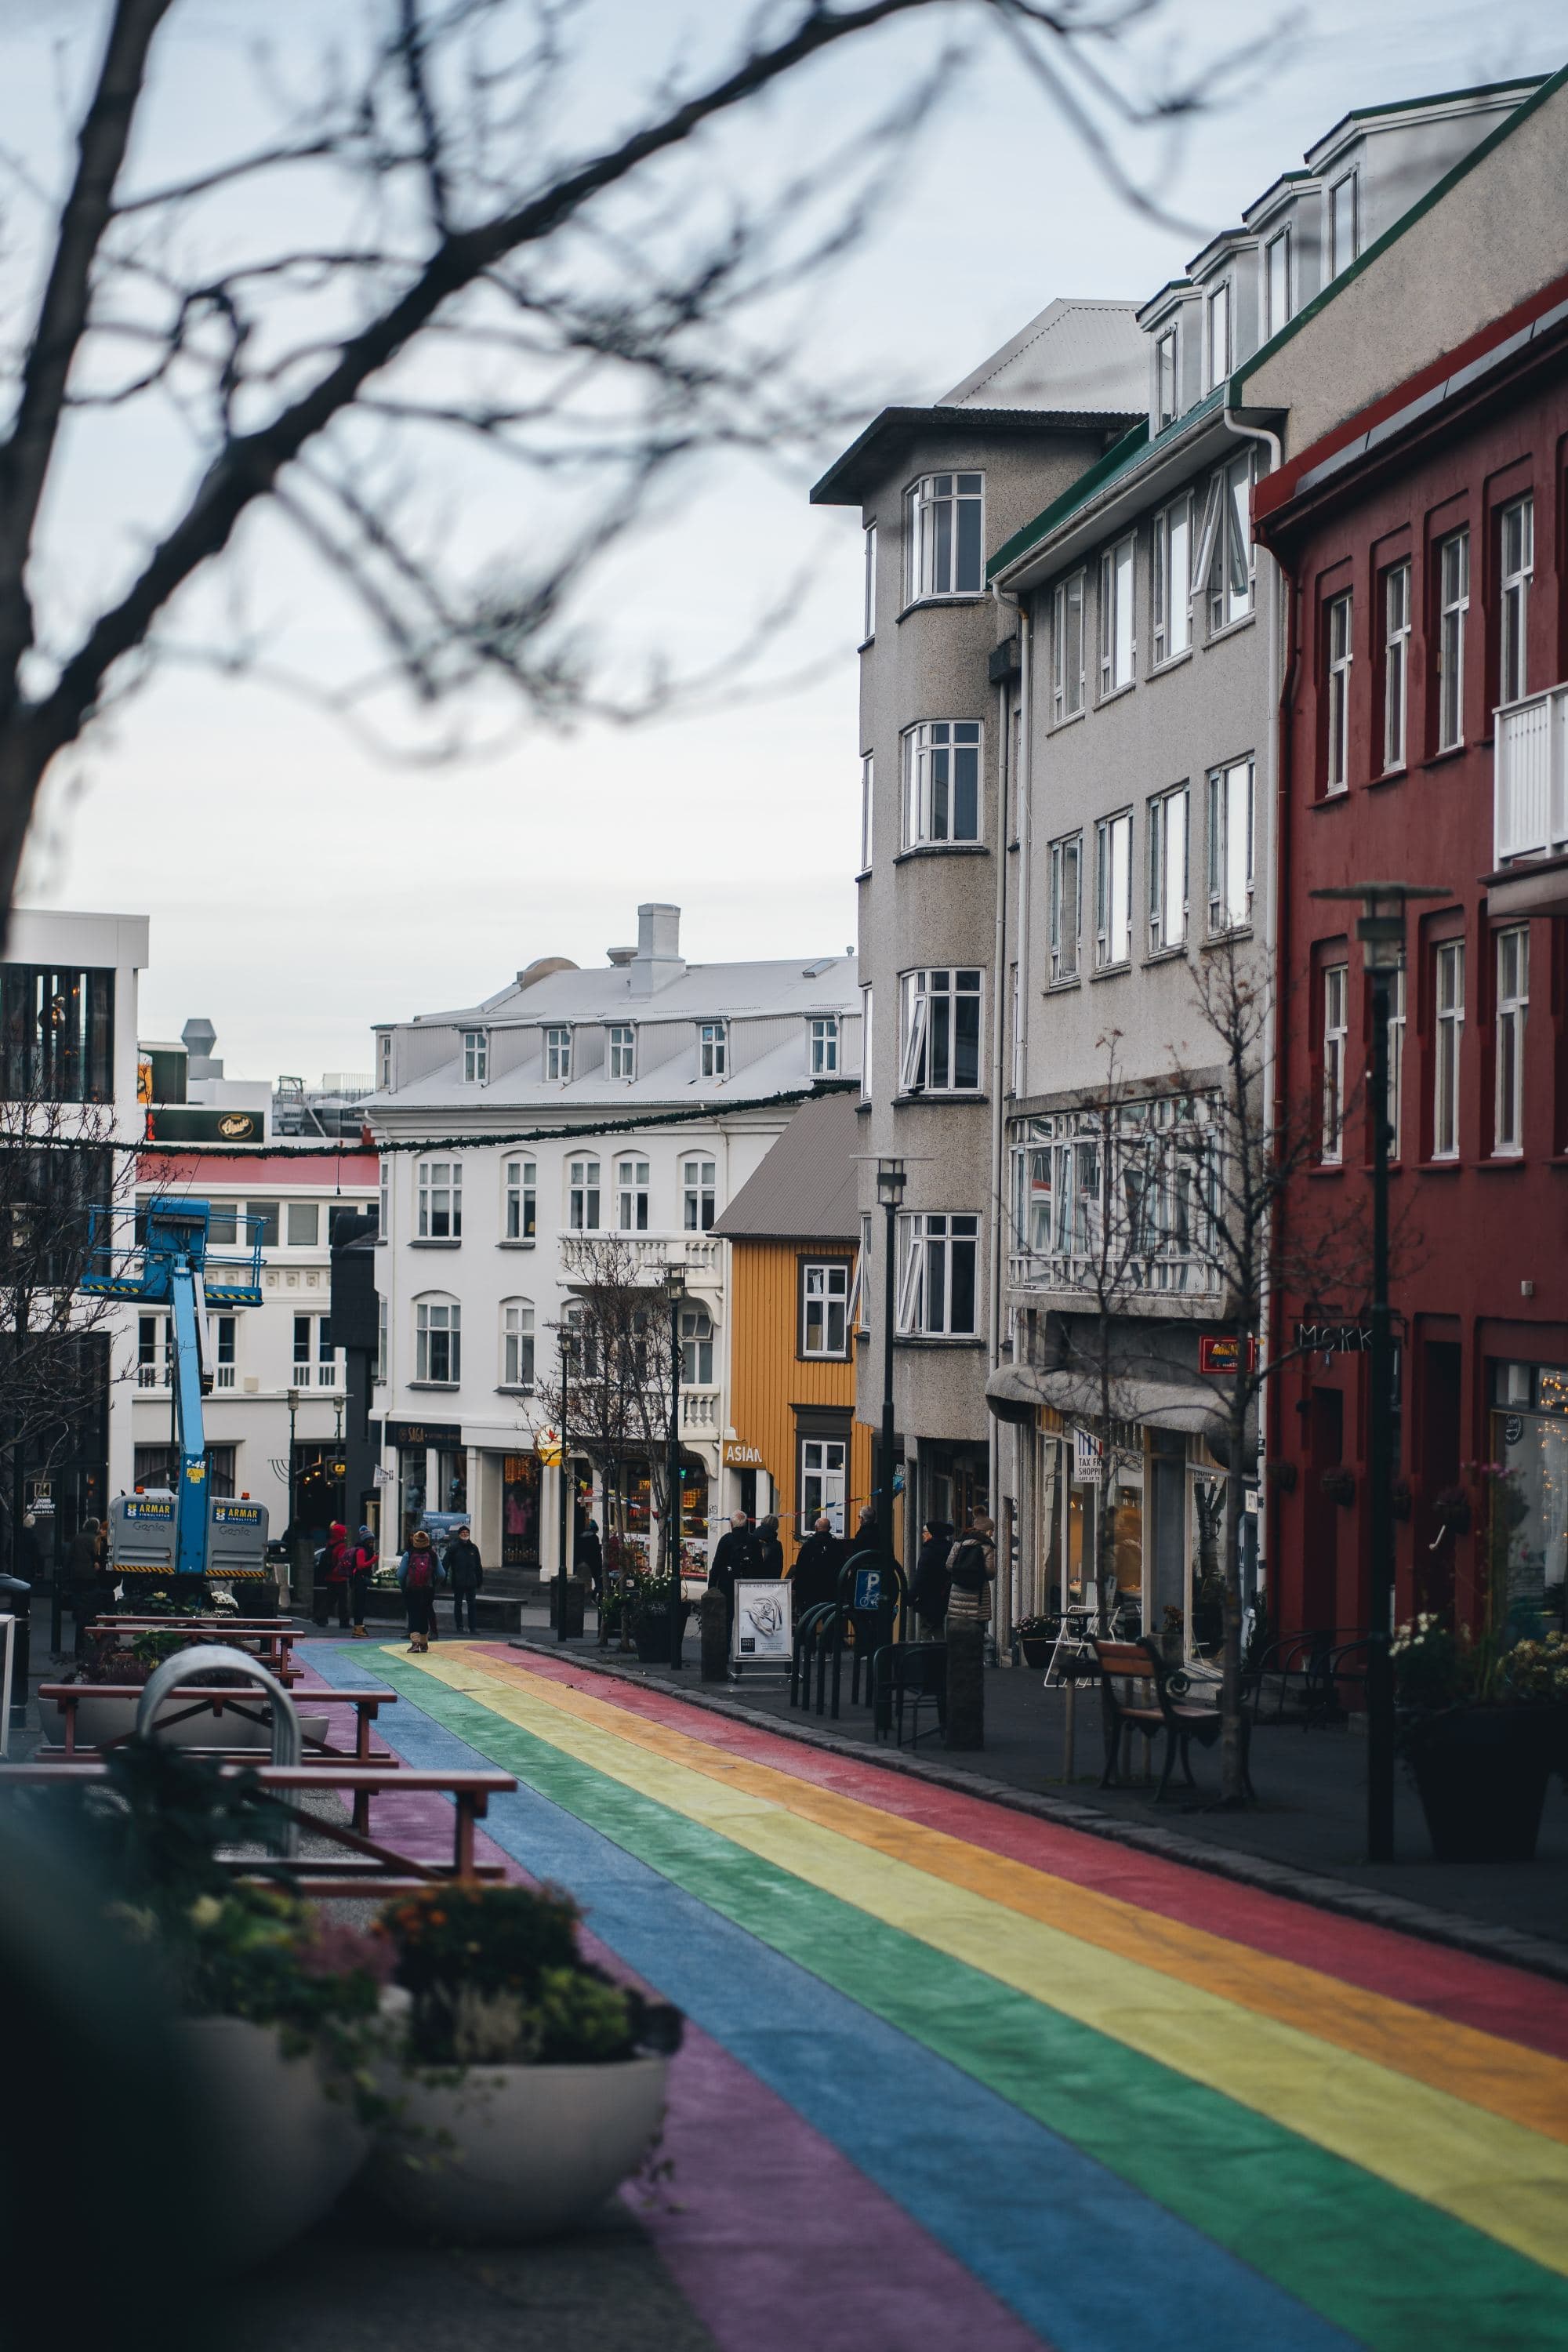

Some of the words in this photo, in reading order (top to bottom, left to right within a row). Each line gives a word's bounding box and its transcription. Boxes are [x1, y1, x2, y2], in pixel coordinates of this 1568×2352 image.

[1300, 1323, 1374, 1355] MOKK
[408, 1427, 424, 1443] SAGA
[726, 1445, 763, 1463] ASIAN
[1078, 1457, 1091, 1467] TAX
[1093, 1457, 1102, 1467] FR
[1078, 1467, 1102, 1475] SHOPPI
[139, 1504, 170, 1514] ARMAR
[228, 1508, 257, 1518] ARMAR
[132, 1521, 165, 1533] Genie
[219, 1525, 251, 1537] Genie
[867, 1573, 880, 1590] P
